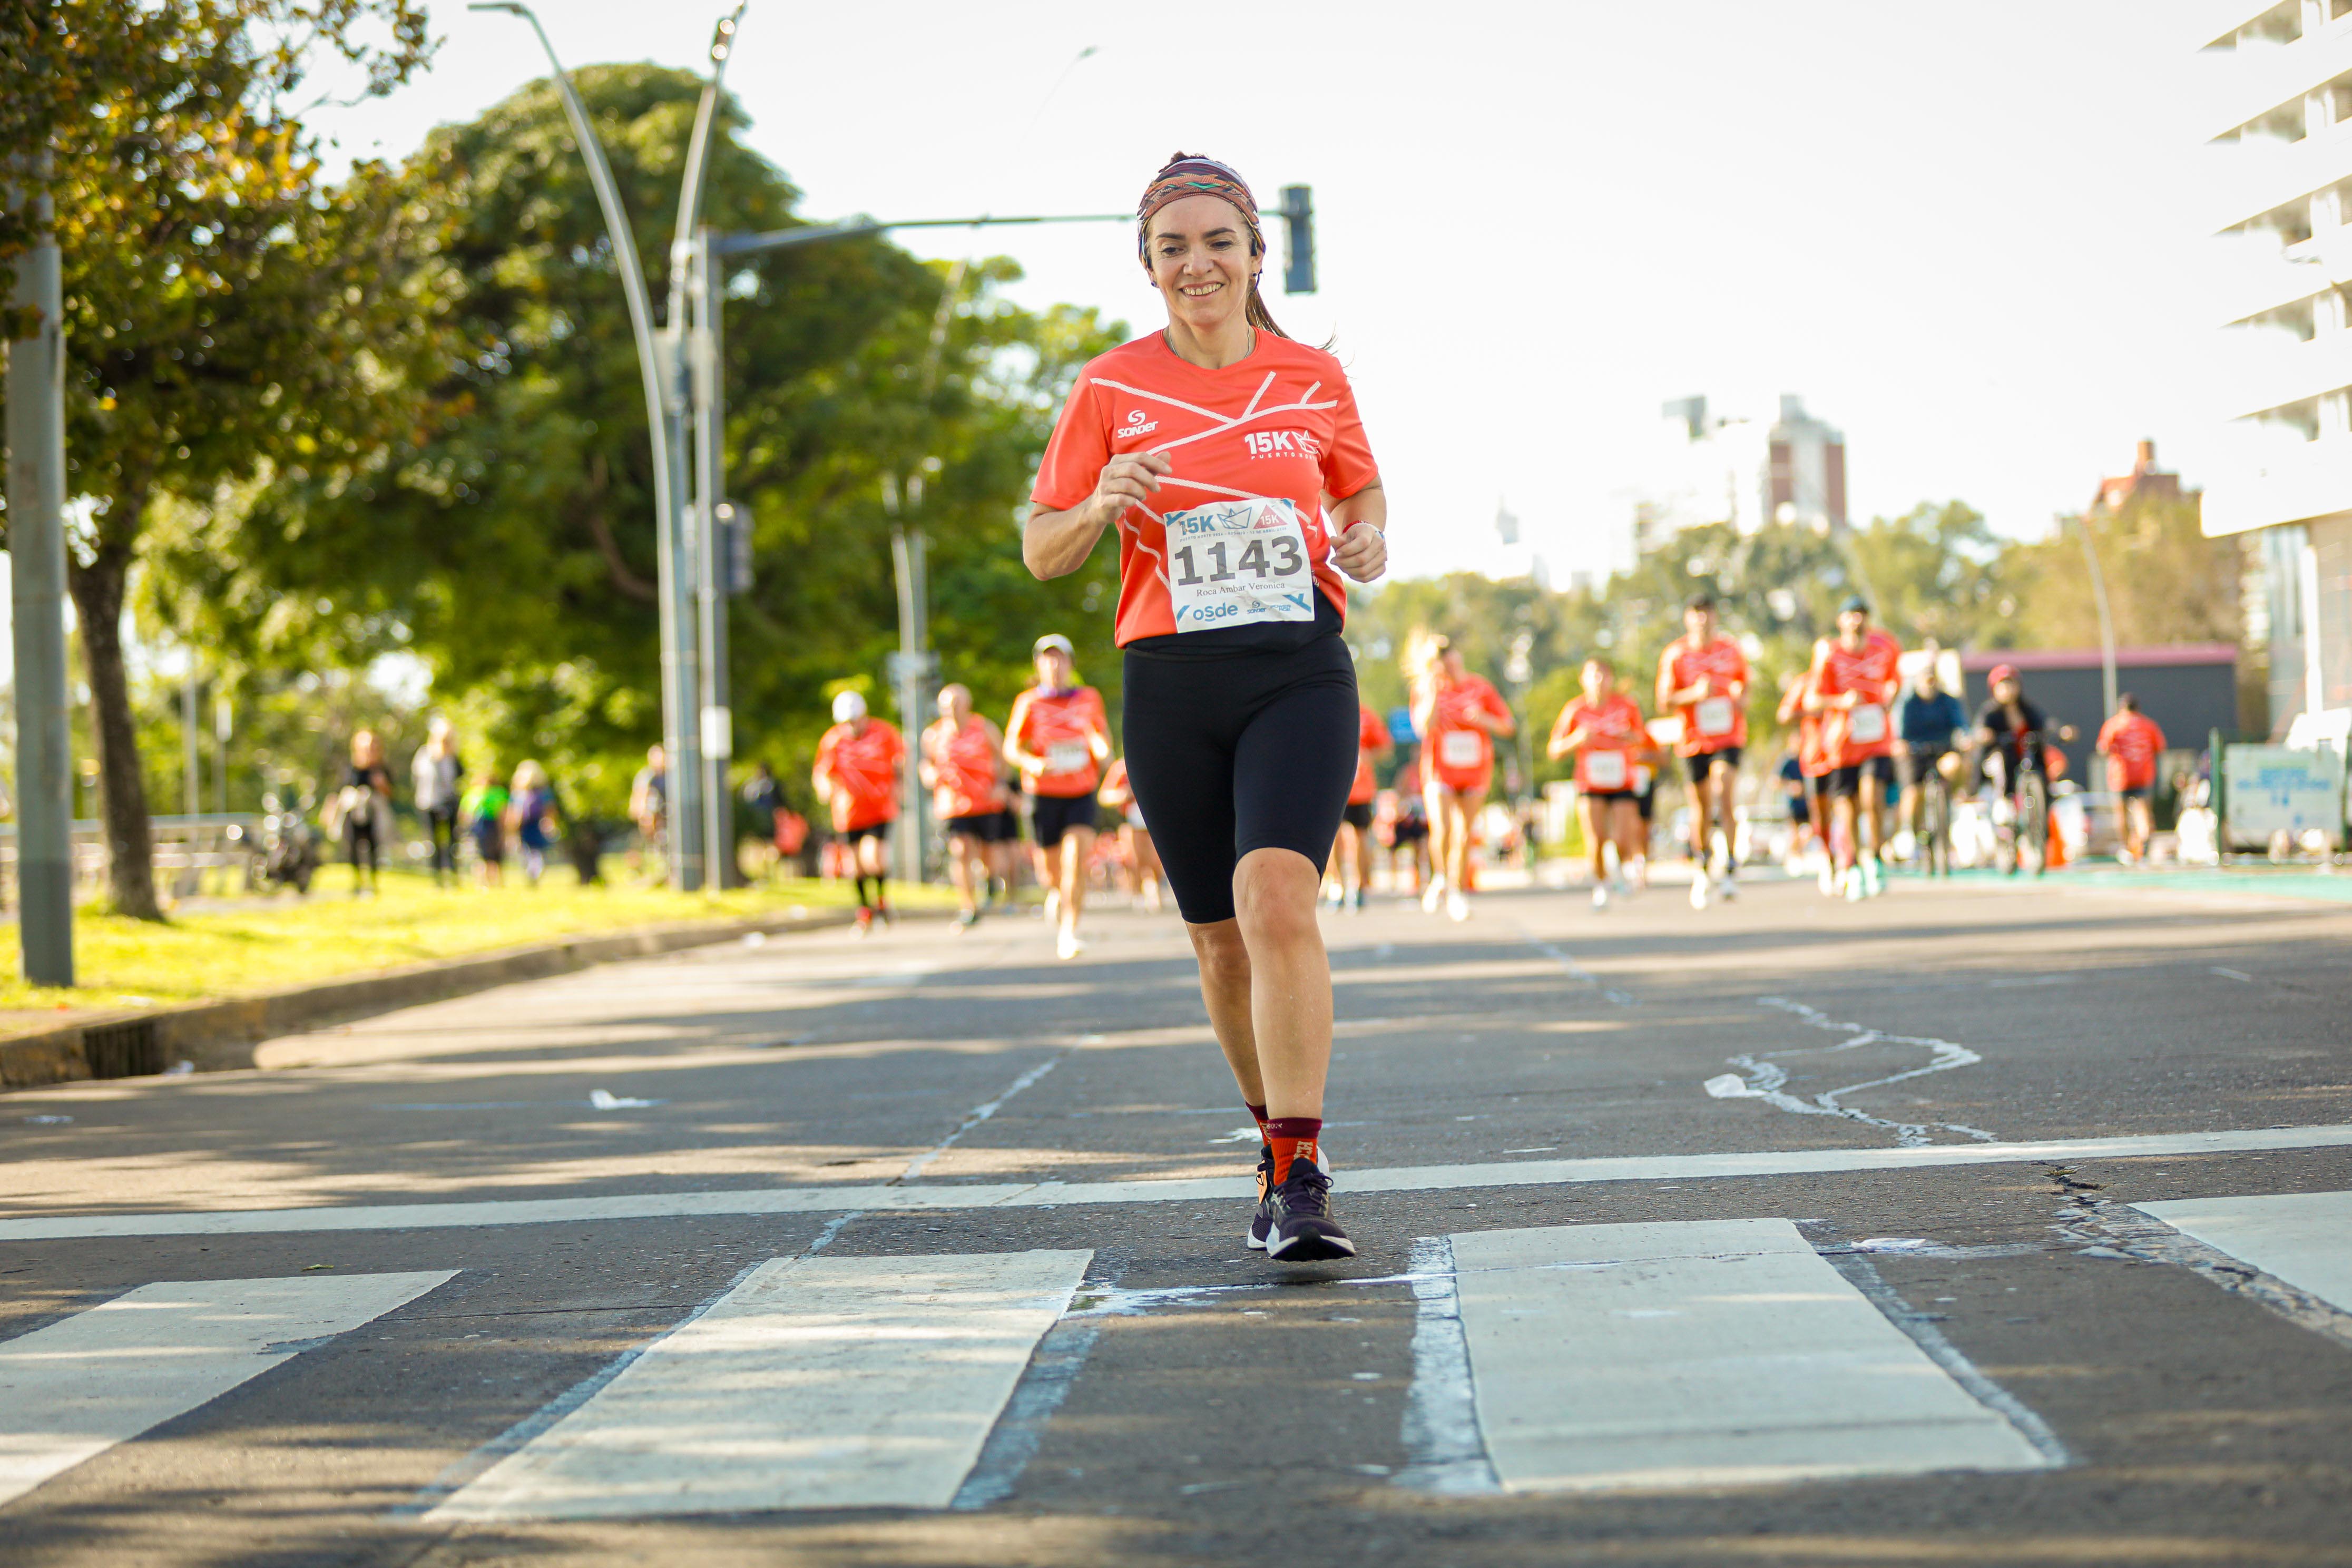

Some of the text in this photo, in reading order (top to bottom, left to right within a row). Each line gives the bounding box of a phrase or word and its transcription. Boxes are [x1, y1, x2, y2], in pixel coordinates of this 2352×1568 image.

[1244, 431, 1293, 454] 15K
[1180, 514, 1216, 535] 15K
[1261, 513, 1279, 525] 15K
[1174, 535, 1302, 586] 1143
[1197, 581, 1286, 597] Roca Ambar Veronica
[1193, 602, 1238, 621] osde
